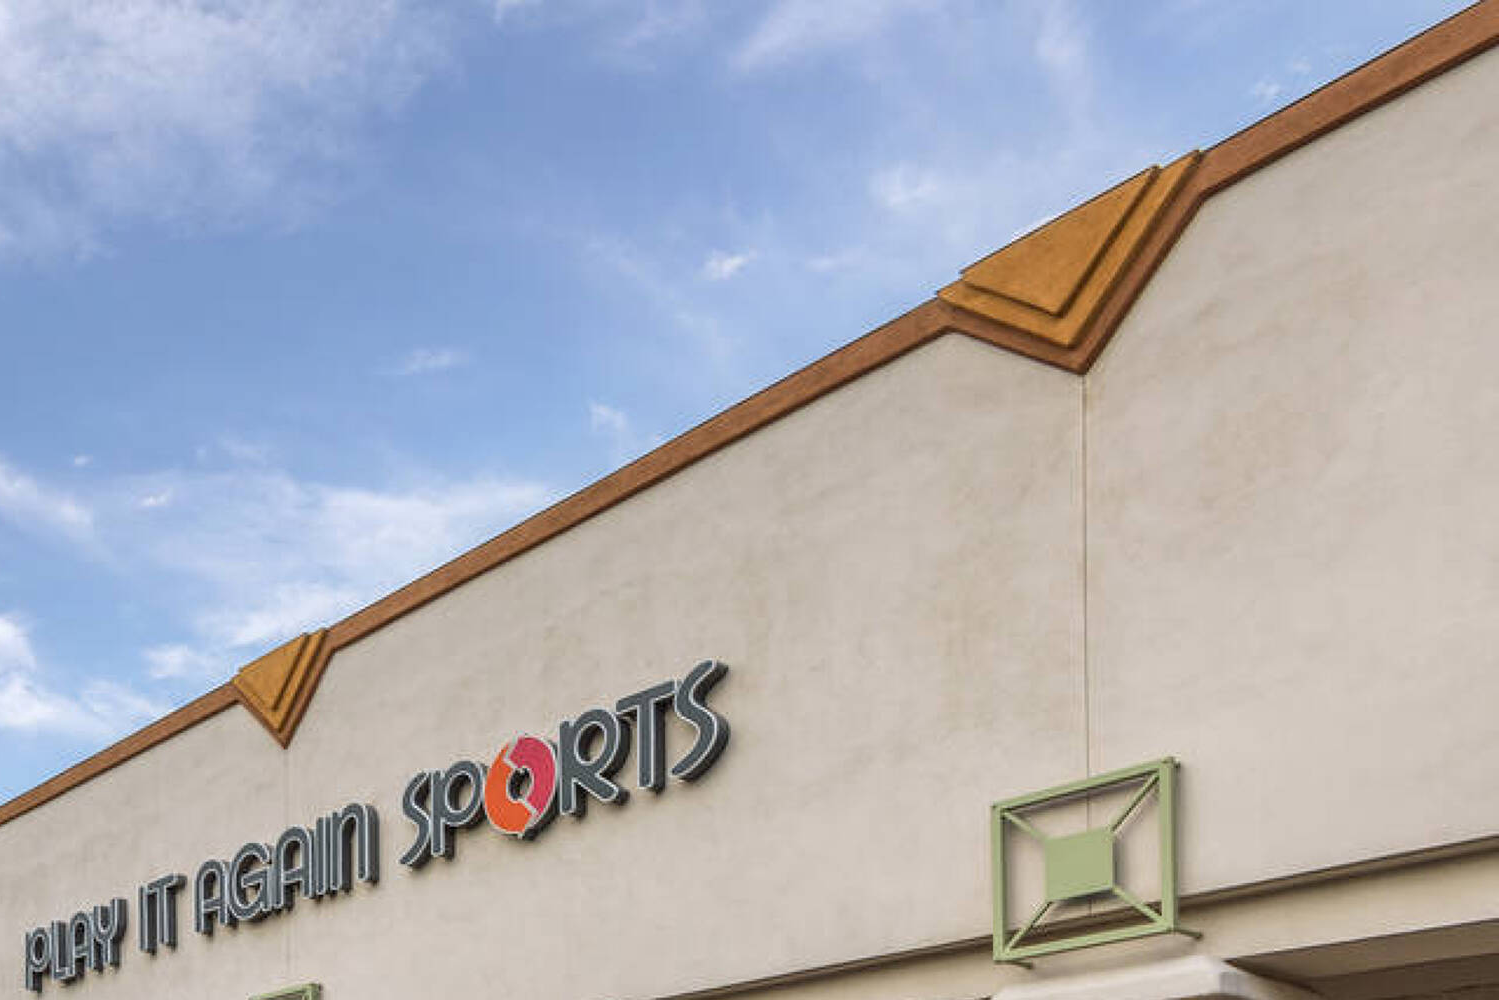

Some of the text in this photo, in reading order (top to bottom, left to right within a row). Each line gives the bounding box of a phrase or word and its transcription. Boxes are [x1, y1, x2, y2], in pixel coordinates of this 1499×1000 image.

[25, 659, 731, 994] PLAY IT AGAIN SPORTS
